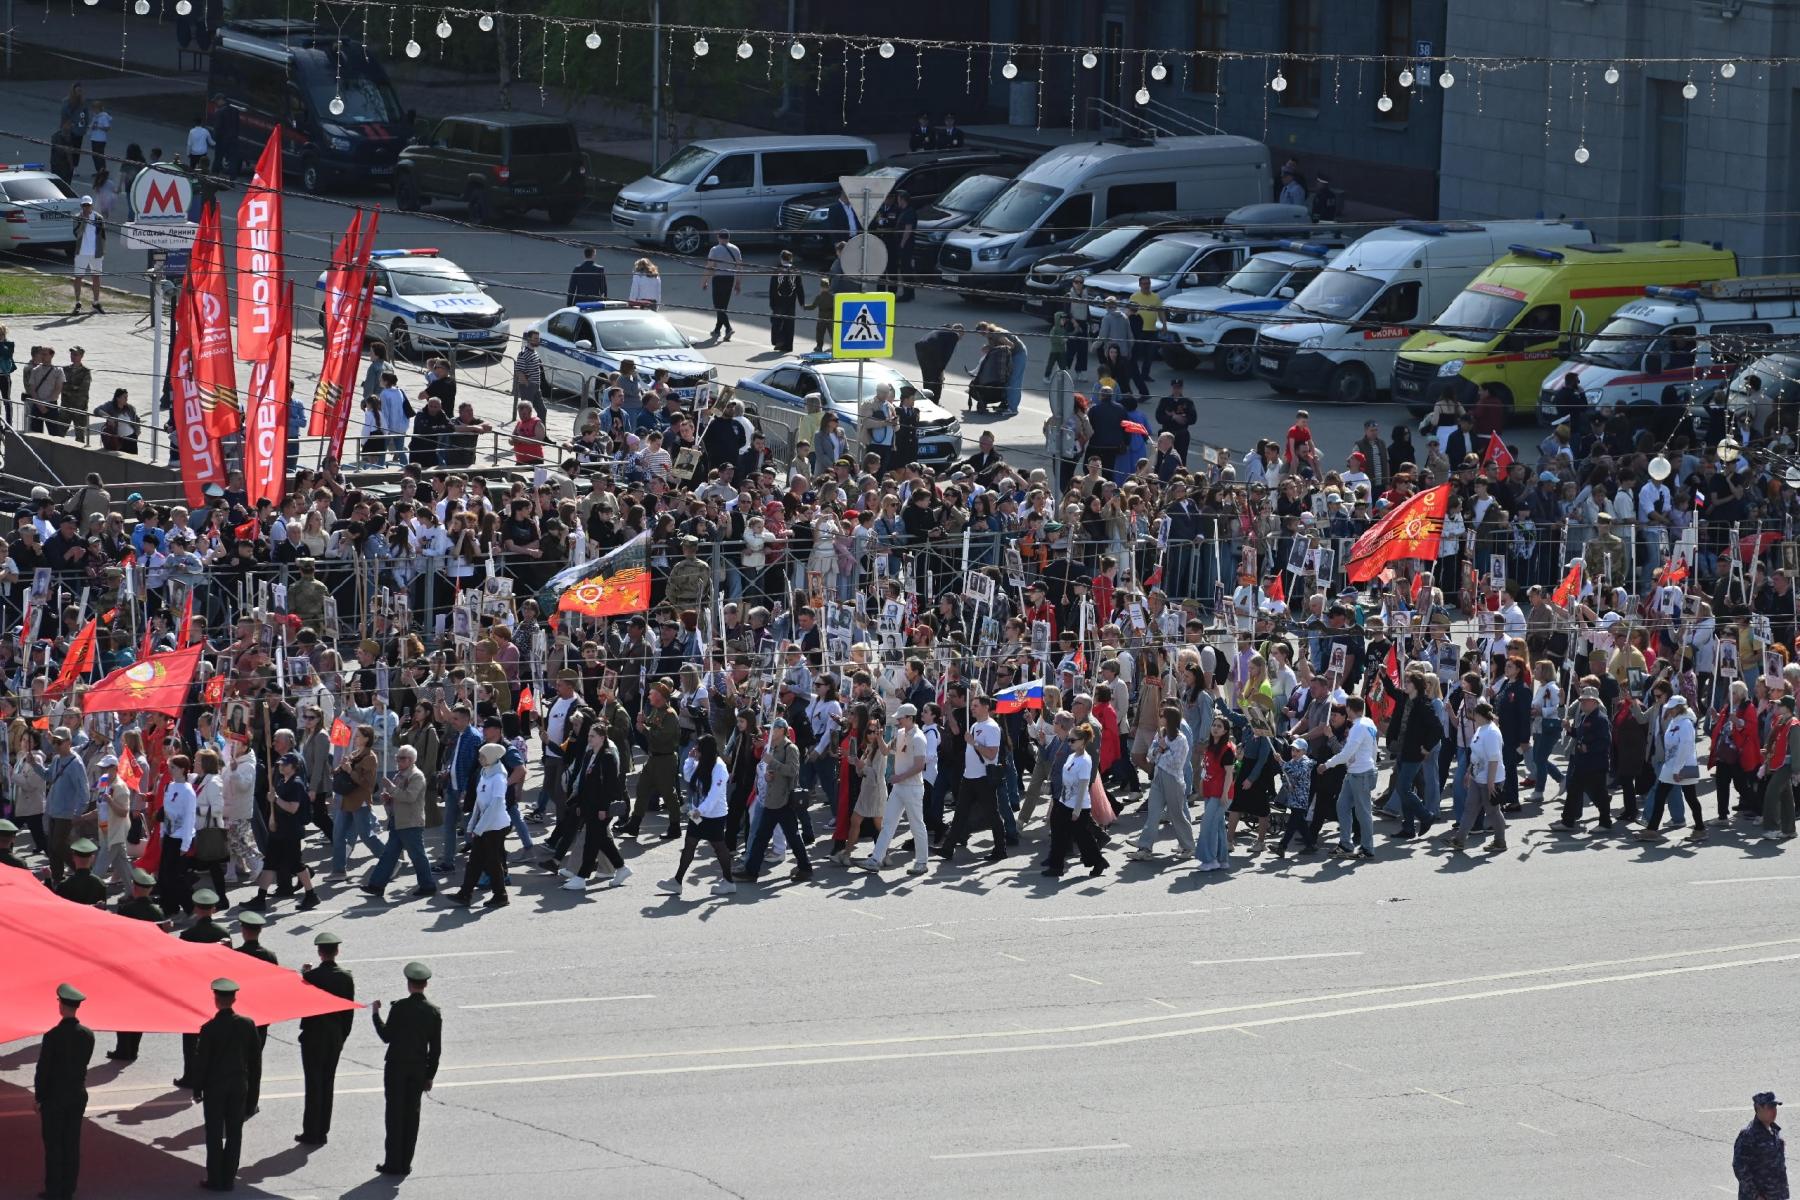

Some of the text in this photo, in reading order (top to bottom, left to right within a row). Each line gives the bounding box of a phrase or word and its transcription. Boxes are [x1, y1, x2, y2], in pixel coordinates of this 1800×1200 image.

[1418, 44, 1430, 56] 38
[143, 178, 183, 214] М
[169, 228, 195, 236] Ленина
[432, 297, 485, 308] ДПС
[1371, 328, 1403, 338] СКОРАЯ
[638, 354, 693, 365] ДПС
